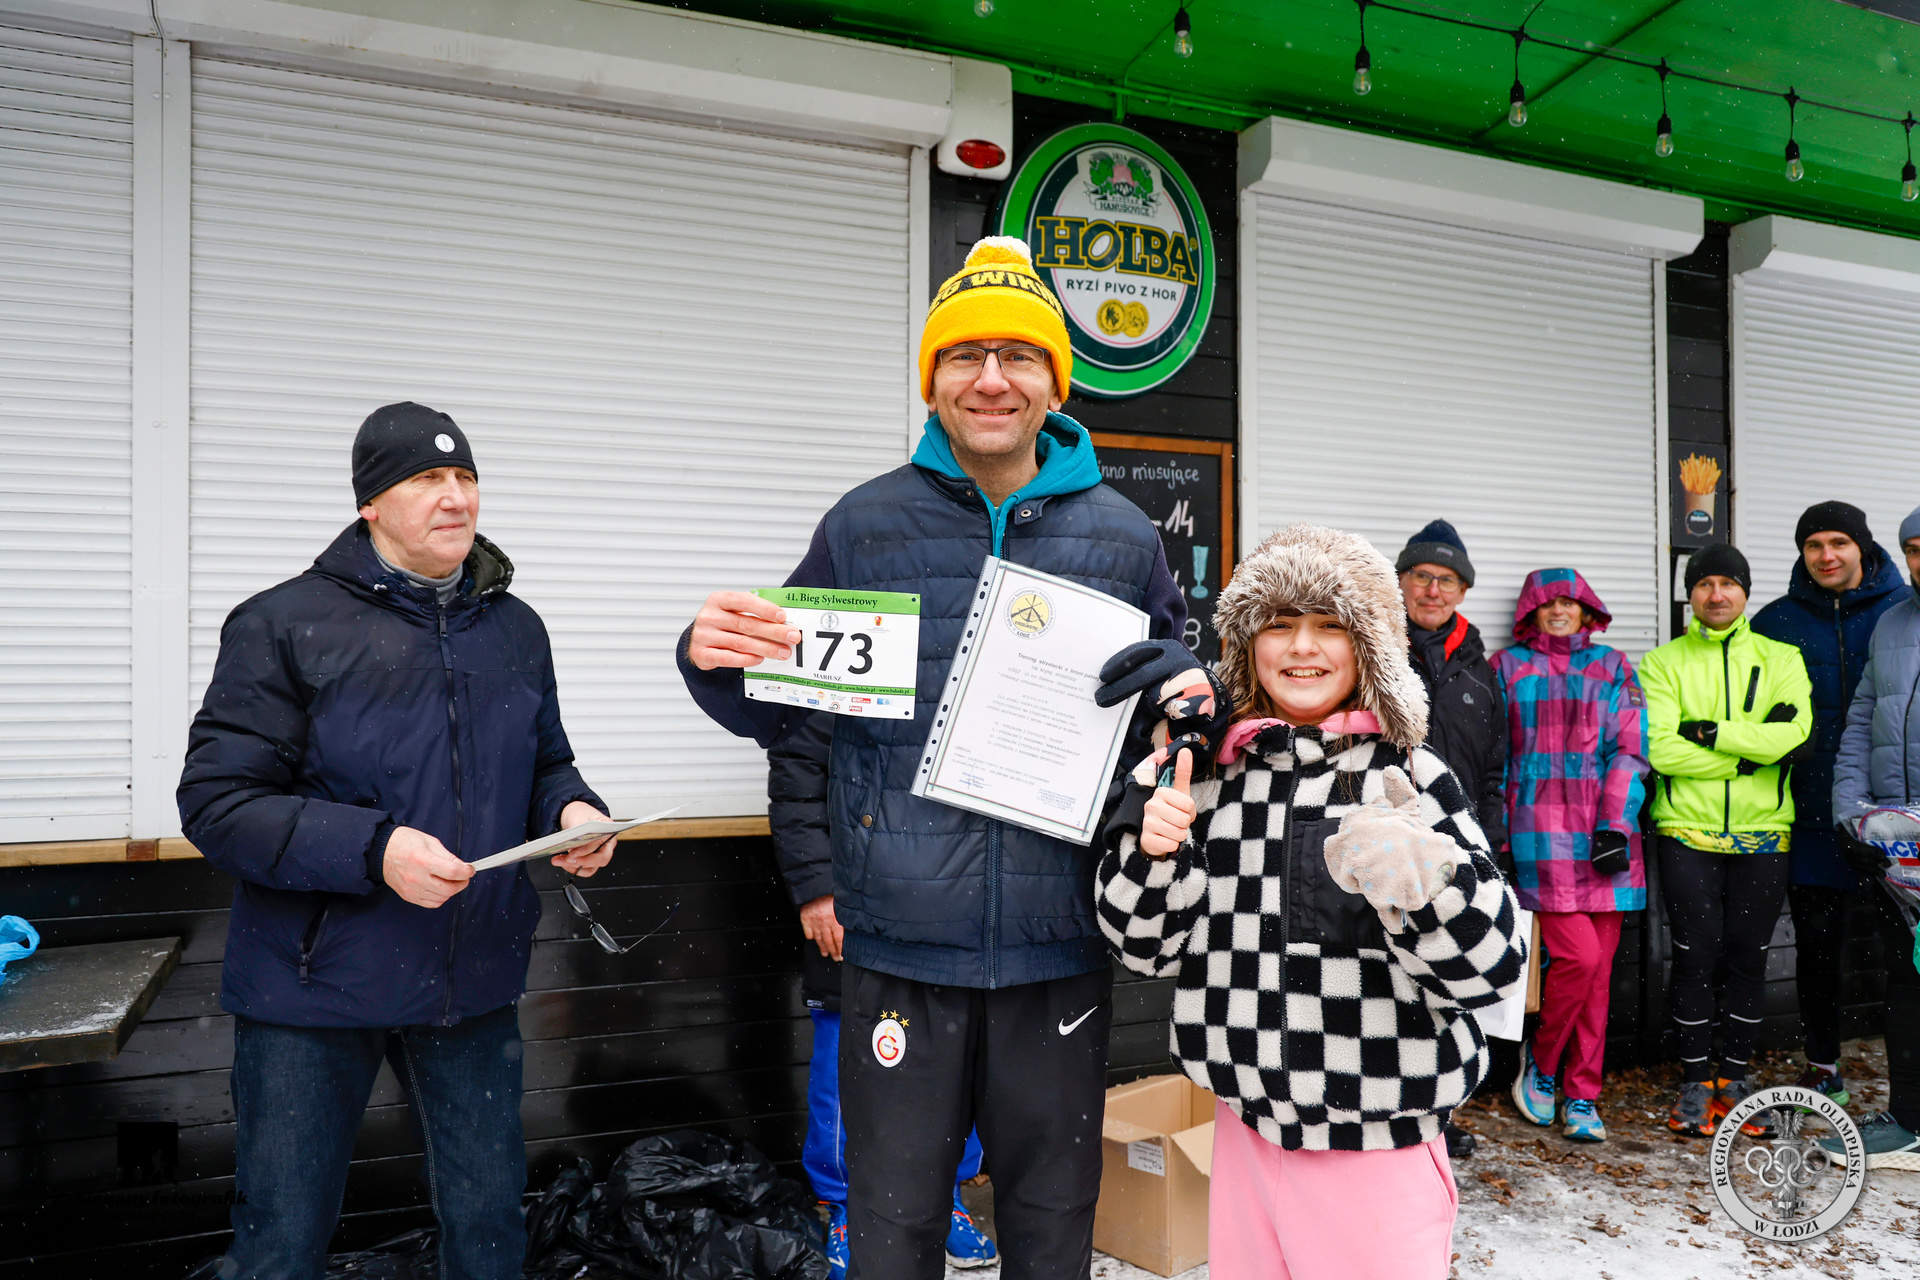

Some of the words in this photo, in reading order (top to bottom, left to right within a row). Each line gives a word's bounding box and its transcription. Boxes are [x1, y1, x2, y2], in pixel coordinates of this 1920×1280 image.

[1066, 278, 1099, 292] RYZÍ
[1105, 282, 1136, 295] PIVO
[1140, 286, 1147, 297] Z
[1152, 288, 1177, 301] HOR
[1132, 460, 1200, 489] musujące
[800, 593, 820, 605] Bieg
[822, 594, 878, 608] Sylwestrowy
[795, 629, 873, 675] 173
[813, 672, 842, 681] MARIUSZ
